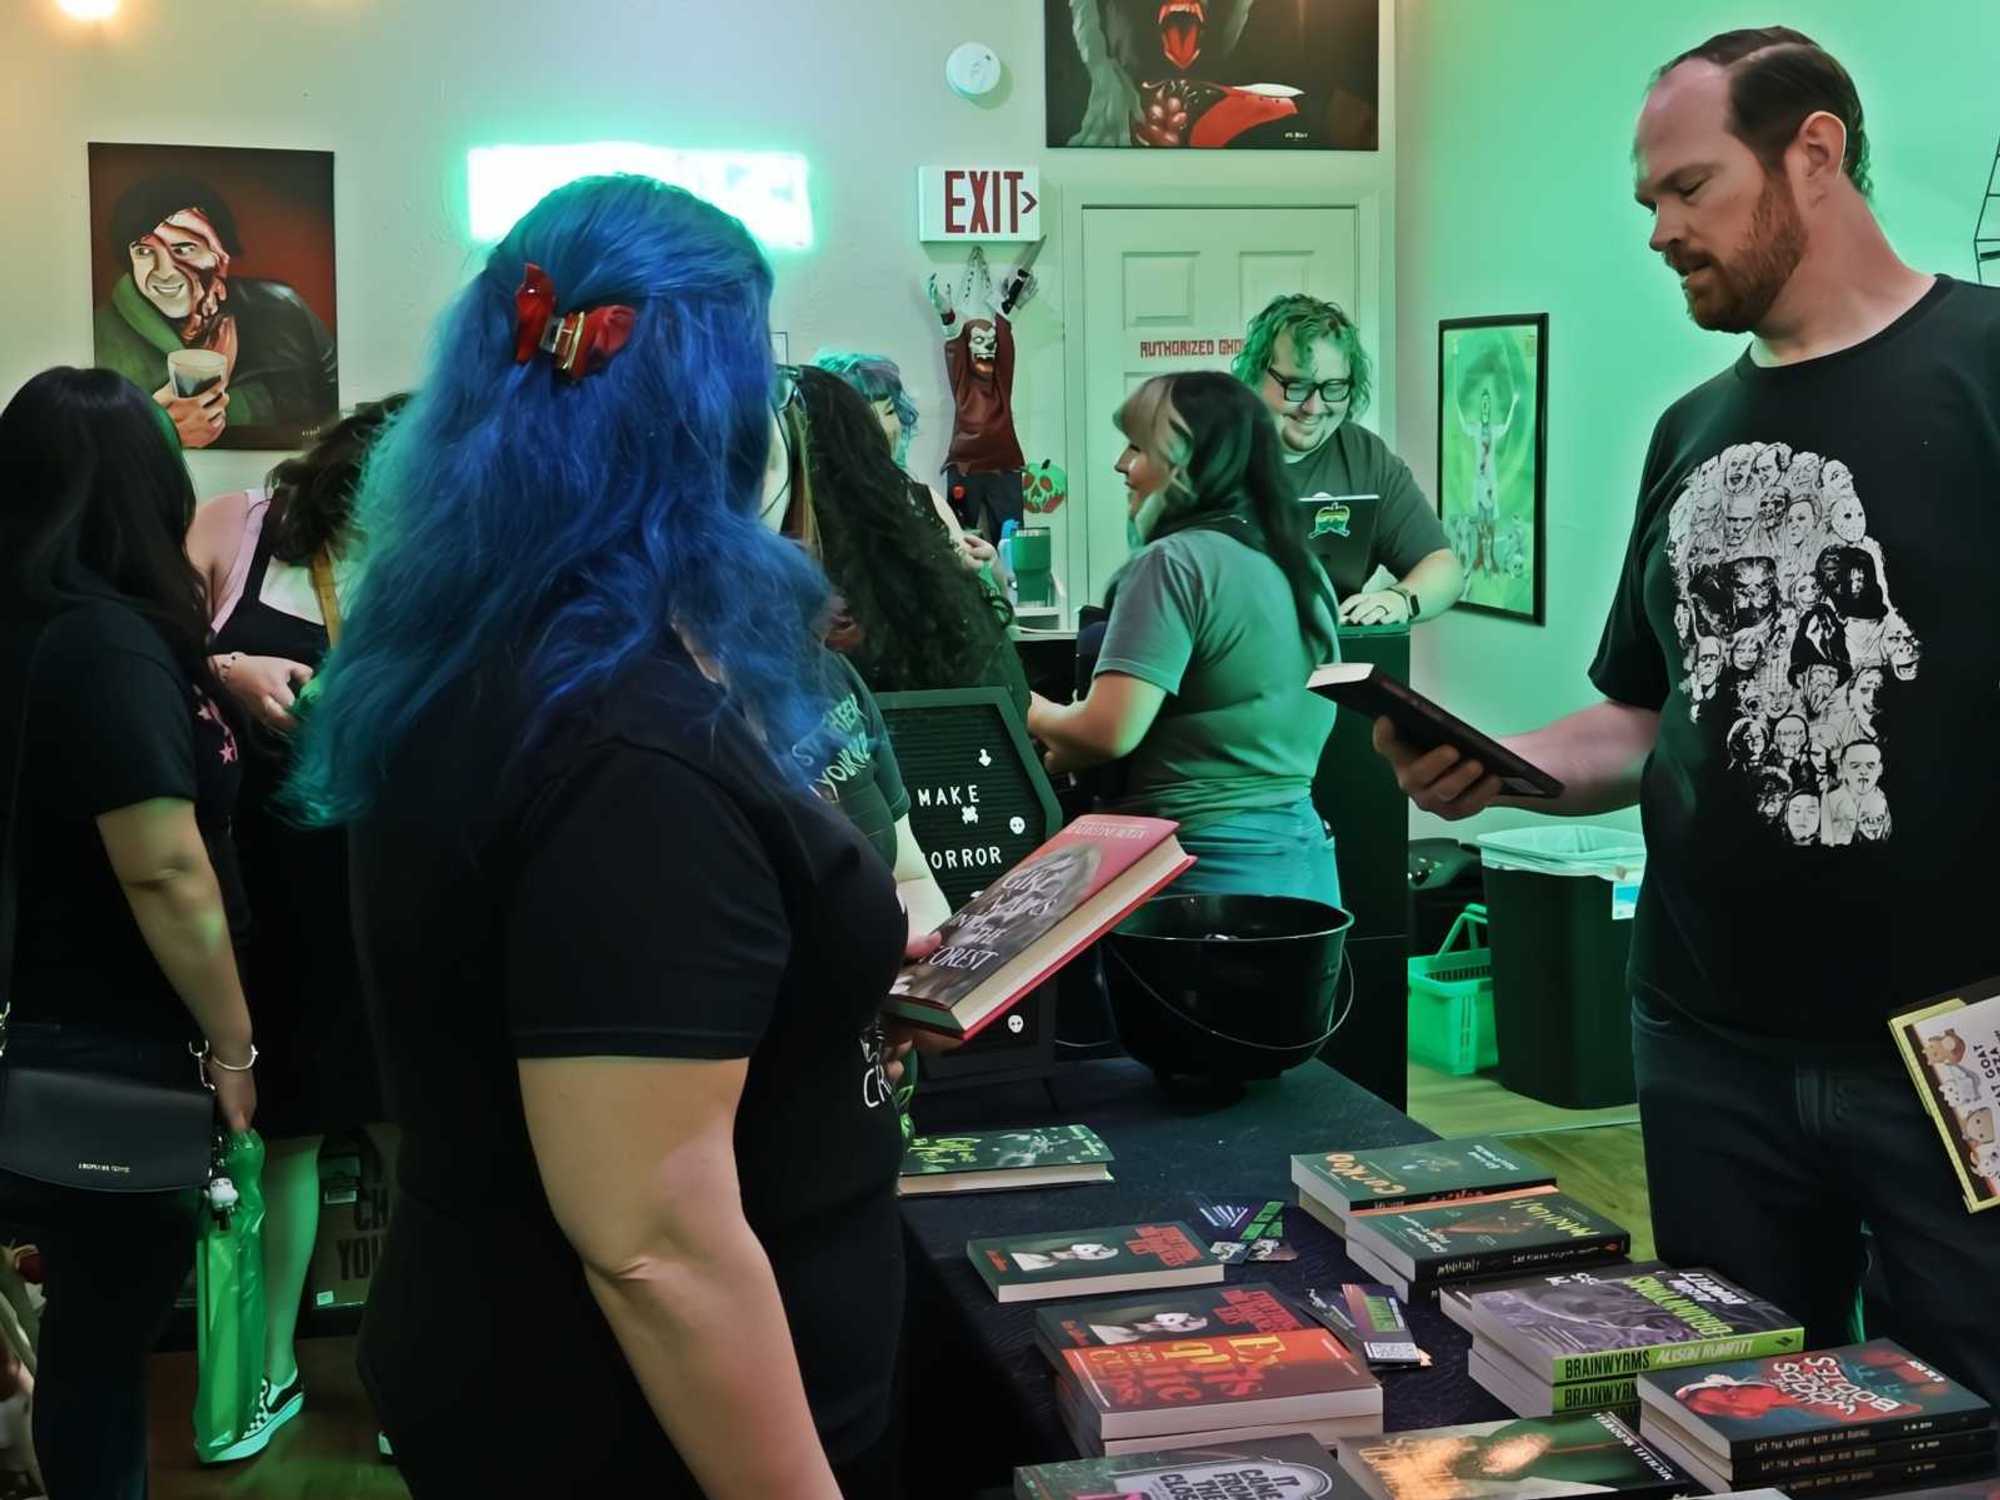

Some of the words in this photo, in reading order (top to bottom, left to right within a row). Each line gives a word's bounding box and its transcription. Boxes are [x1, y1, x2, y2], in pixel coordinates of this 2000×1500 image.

[945, 170, 1024, 233] EXIT
[1140, 339, 1214, 358] AUTHORIZED
[917, 784, 980, 806] MAKE
[922, 846, 1002, 870] ORROR
[919, 946, 999, 970] OREST
[1565, 1350, 1650, 1379] BRAINWYRMS
[1656, 1345, 1701, 1364] ALISON
[1701, 1339, 1753, 1361] RUMFITT
[1804, 1356, 1901, 1412] BODIES
[1271, 1475, 1300, 1487] IT
